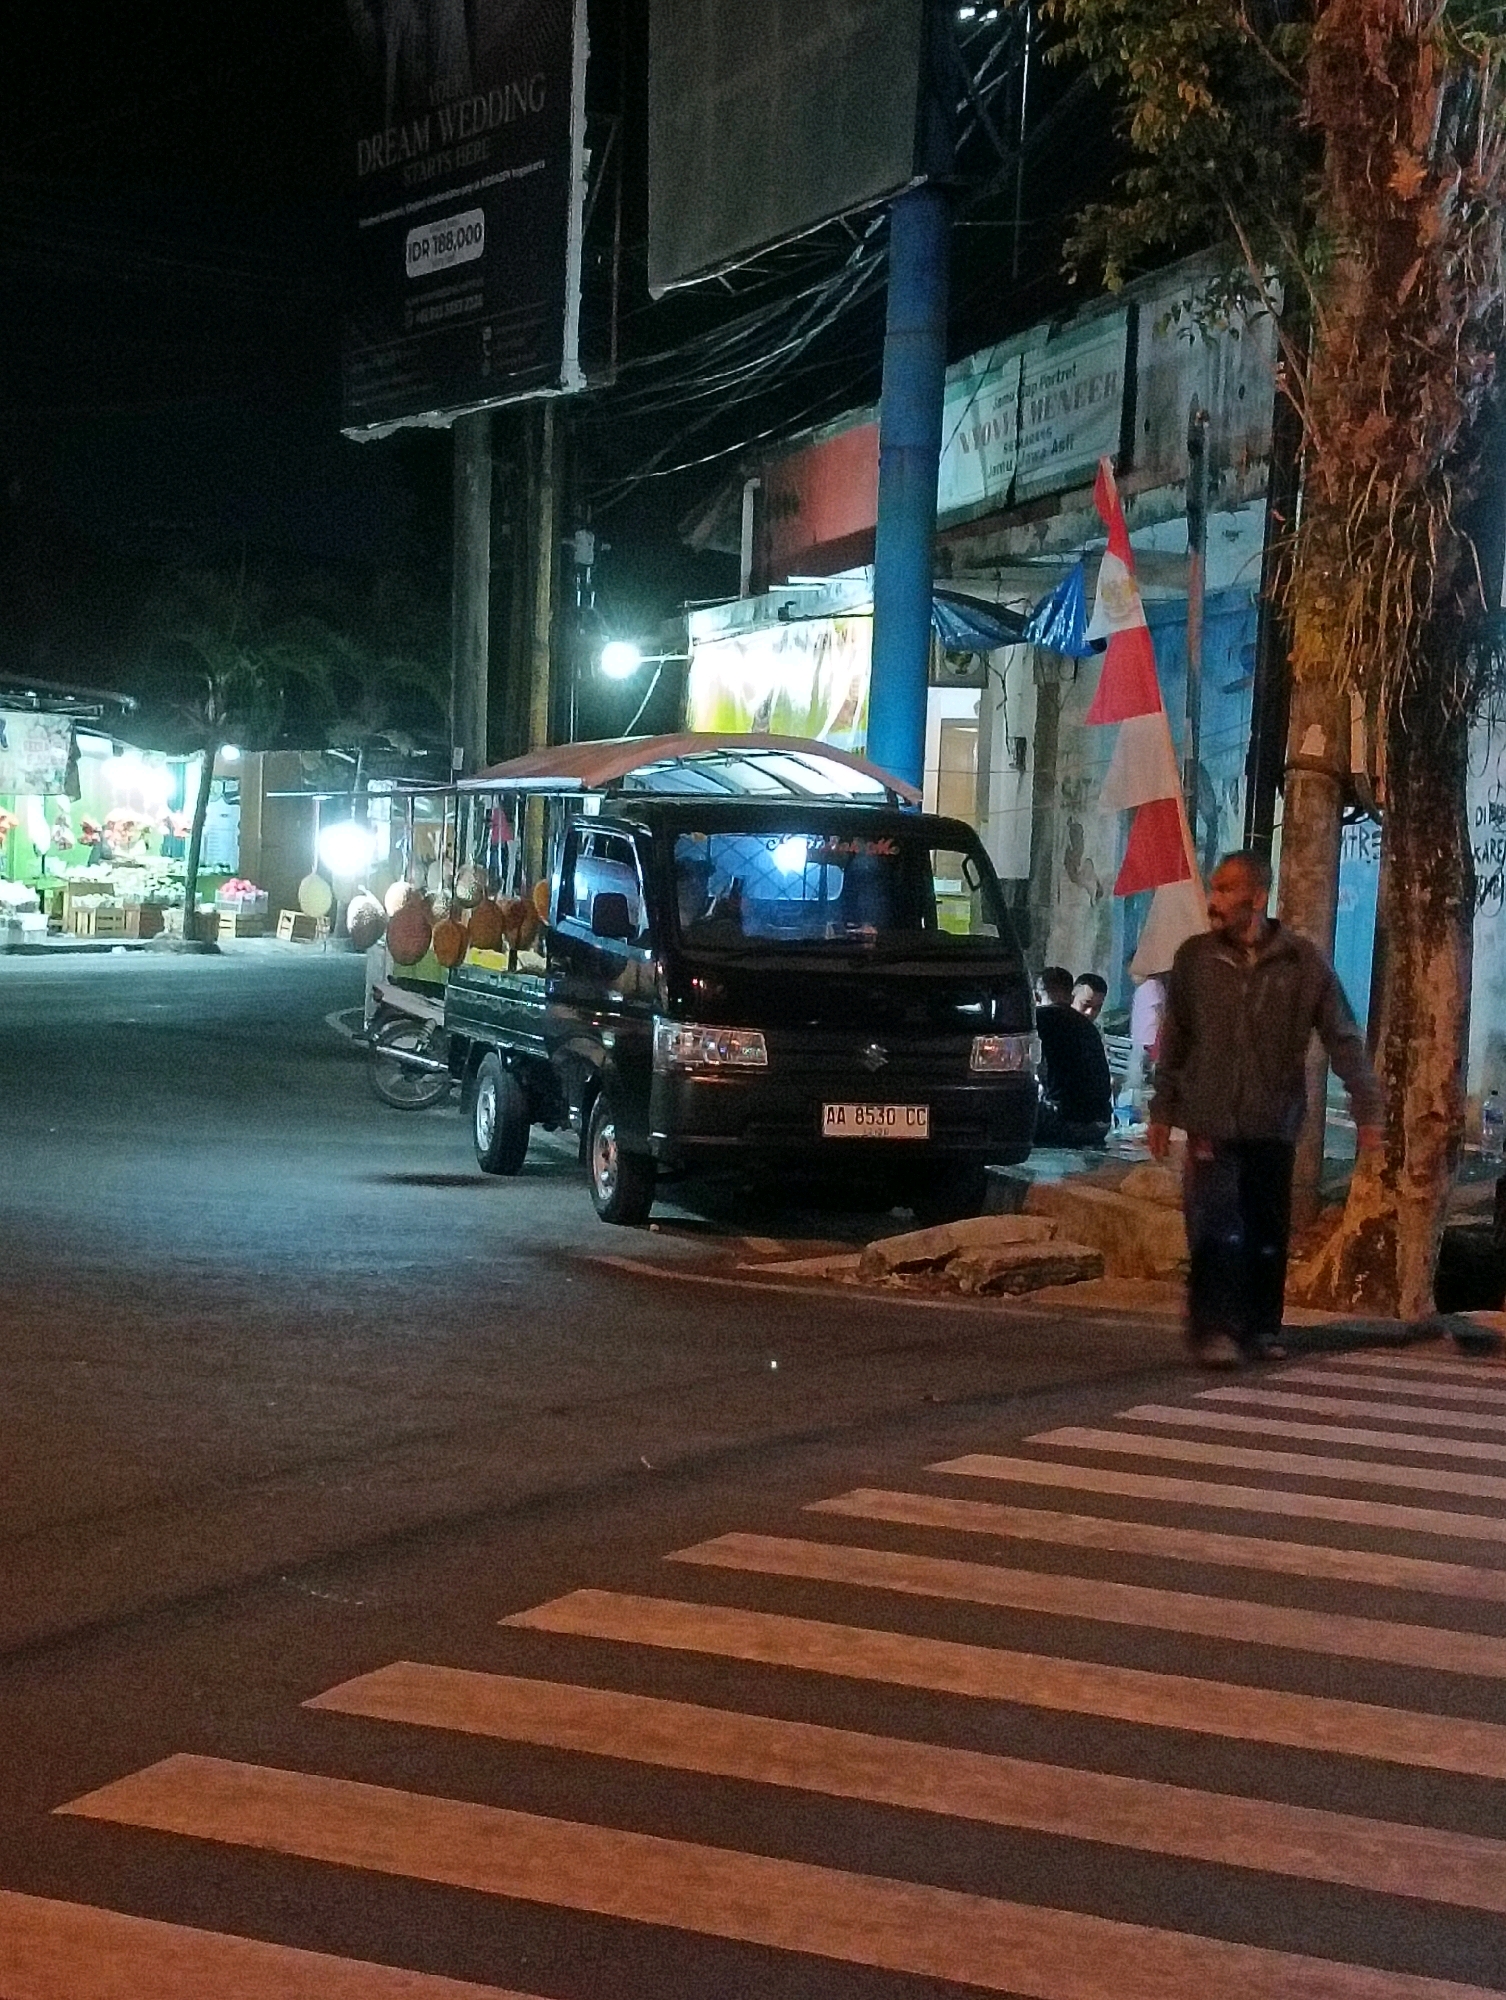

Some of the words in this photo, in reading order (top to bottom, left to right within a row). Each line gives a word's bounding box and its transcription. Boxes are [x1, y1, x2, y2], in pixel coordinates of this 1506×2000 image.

[357, 115, 430, 176] DREAM
[437, 72, 547, 145] WEDDING
[407, 239, 430, 263] IDR
[826, 1106, 846, 1126] AA
[855, 1106, 895, 1126] 8530
[906, 1107, 926, 1126] CC
